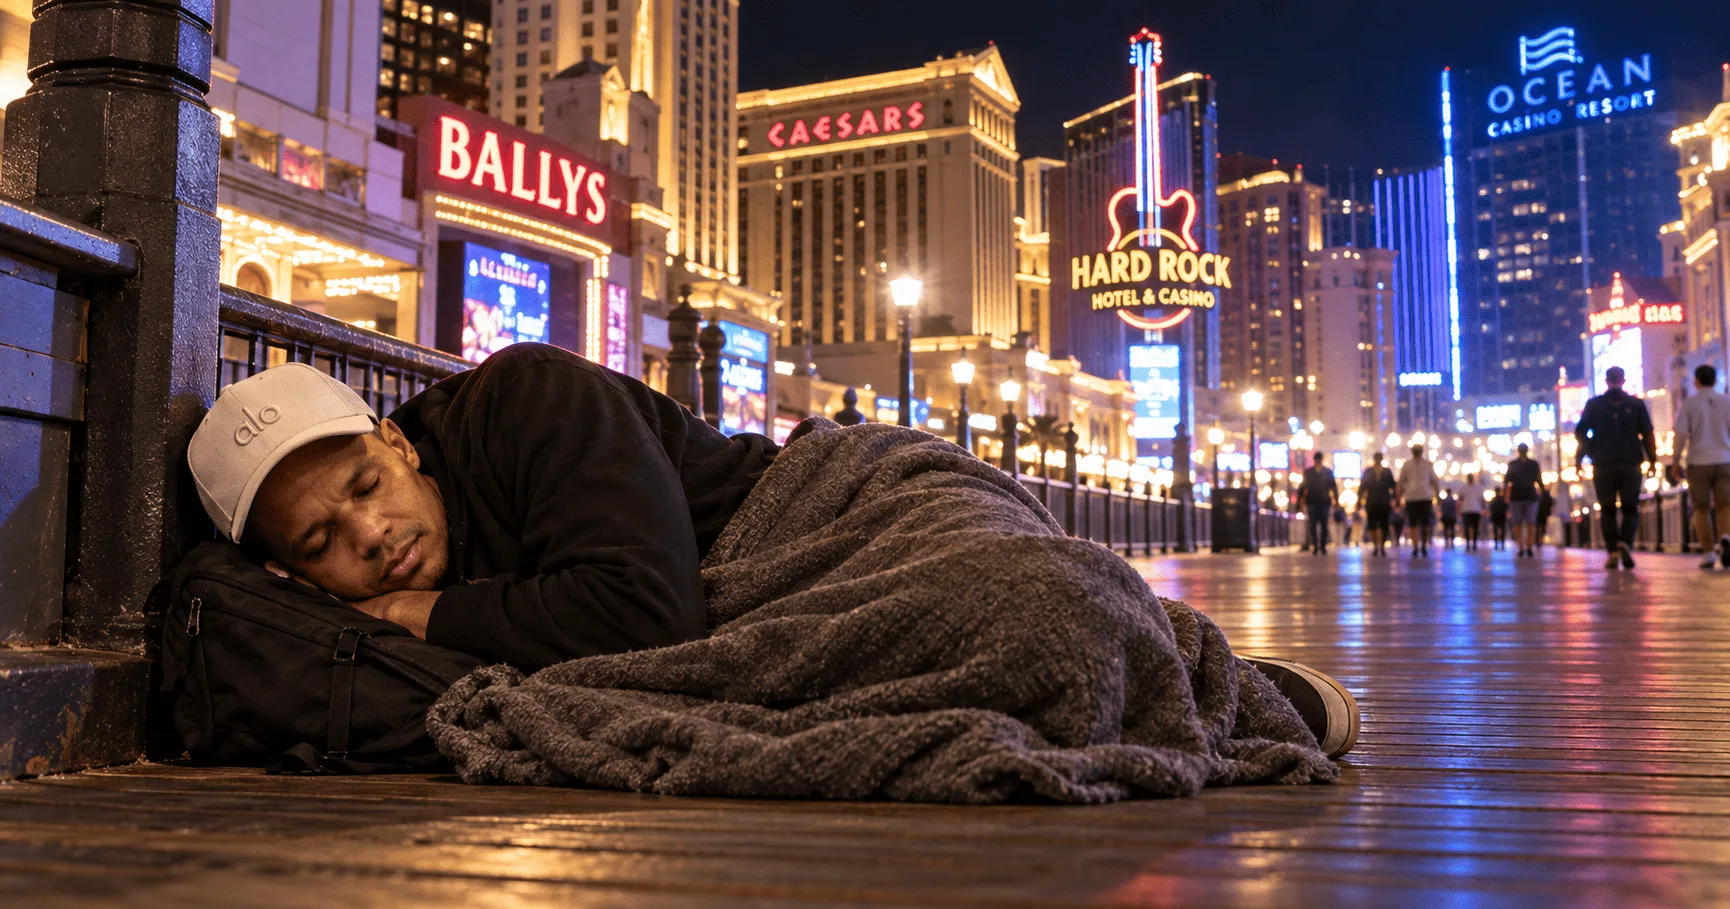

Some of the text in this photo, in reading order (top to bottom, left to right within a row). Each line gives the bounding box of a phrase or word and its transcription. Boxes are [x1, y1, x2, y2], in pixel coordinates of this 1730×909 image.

[1487, 53, 1651, 114] OCEAN
[767, 101, 925, 148] CAESARS
[1487, 88, 1656, 137] CASINO RESORT
[438, 115, 607, 225] BALLYS
[1071, 249, 1232, 290] HARD ROCK
[1091, 287, 1215, 310] HOTEL & CASINO
[234, 404, 281, 446] alo
